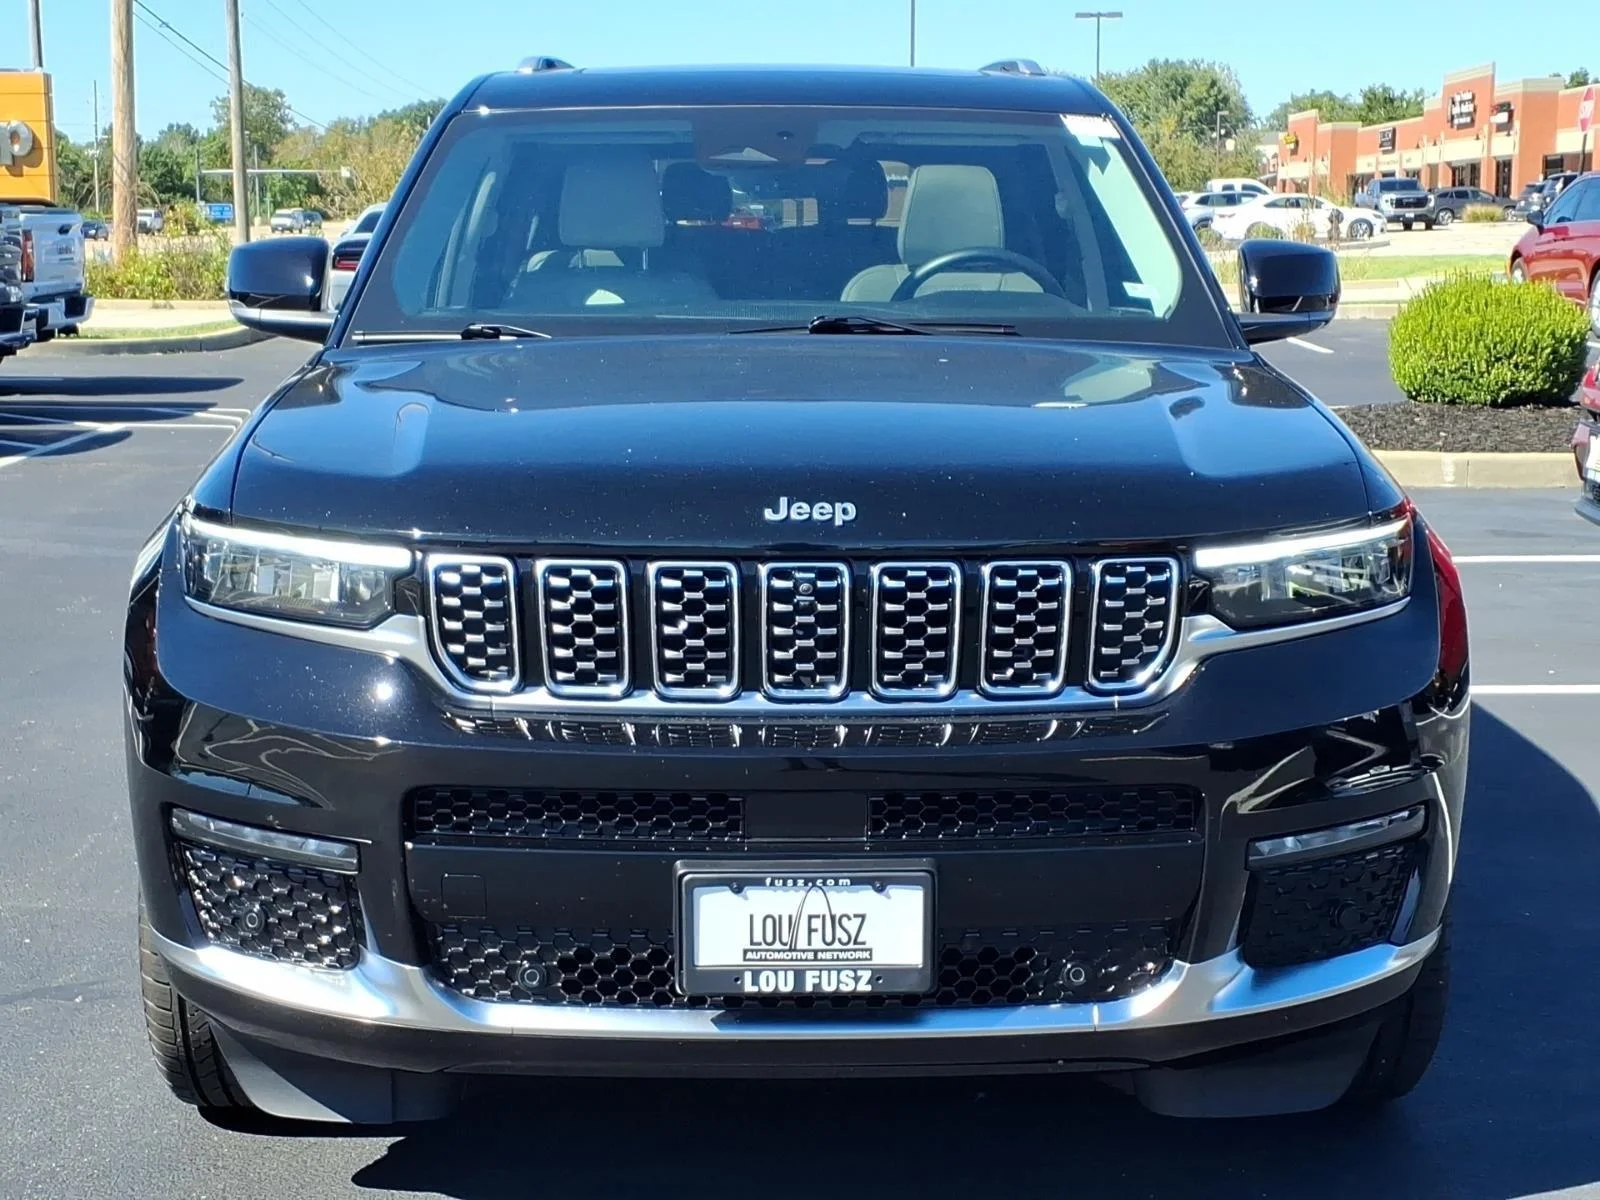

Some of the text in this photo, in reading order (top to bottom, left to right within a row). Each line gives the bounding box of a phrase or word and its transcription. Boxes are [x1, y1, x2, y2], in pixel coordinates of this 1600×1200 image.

[764, 496, 857, 526] Jeep
[765, 877, 851, 887] fusz.com
[749, 914, 867, 947] LOU FUSZ
[745, 950, 871, 960] AUTOMOTIVE NETWORK
[744, 970, 873, 992] LOU FUSZ
